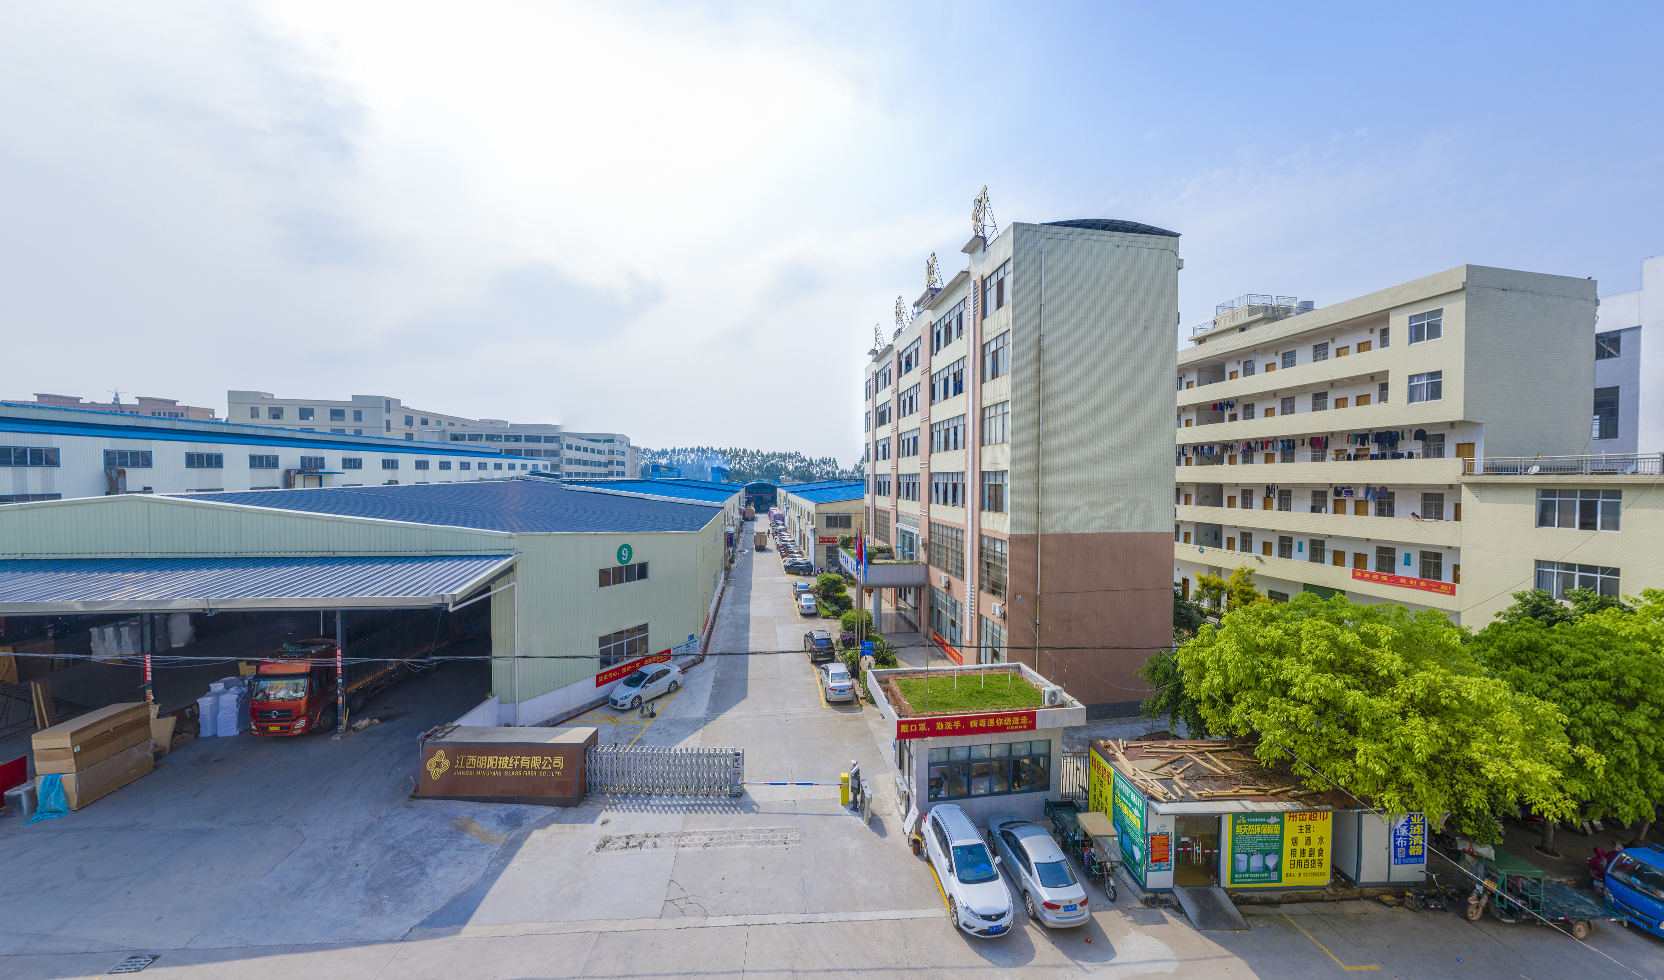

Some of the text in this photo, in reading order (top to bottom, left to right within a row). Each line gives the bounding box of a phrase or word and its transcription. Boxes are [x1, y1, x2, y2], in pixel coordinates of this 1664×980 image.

[621, 547, 629, 561] 9
[455, 755, 564, 770] 江西明阳玻纤有限公司
